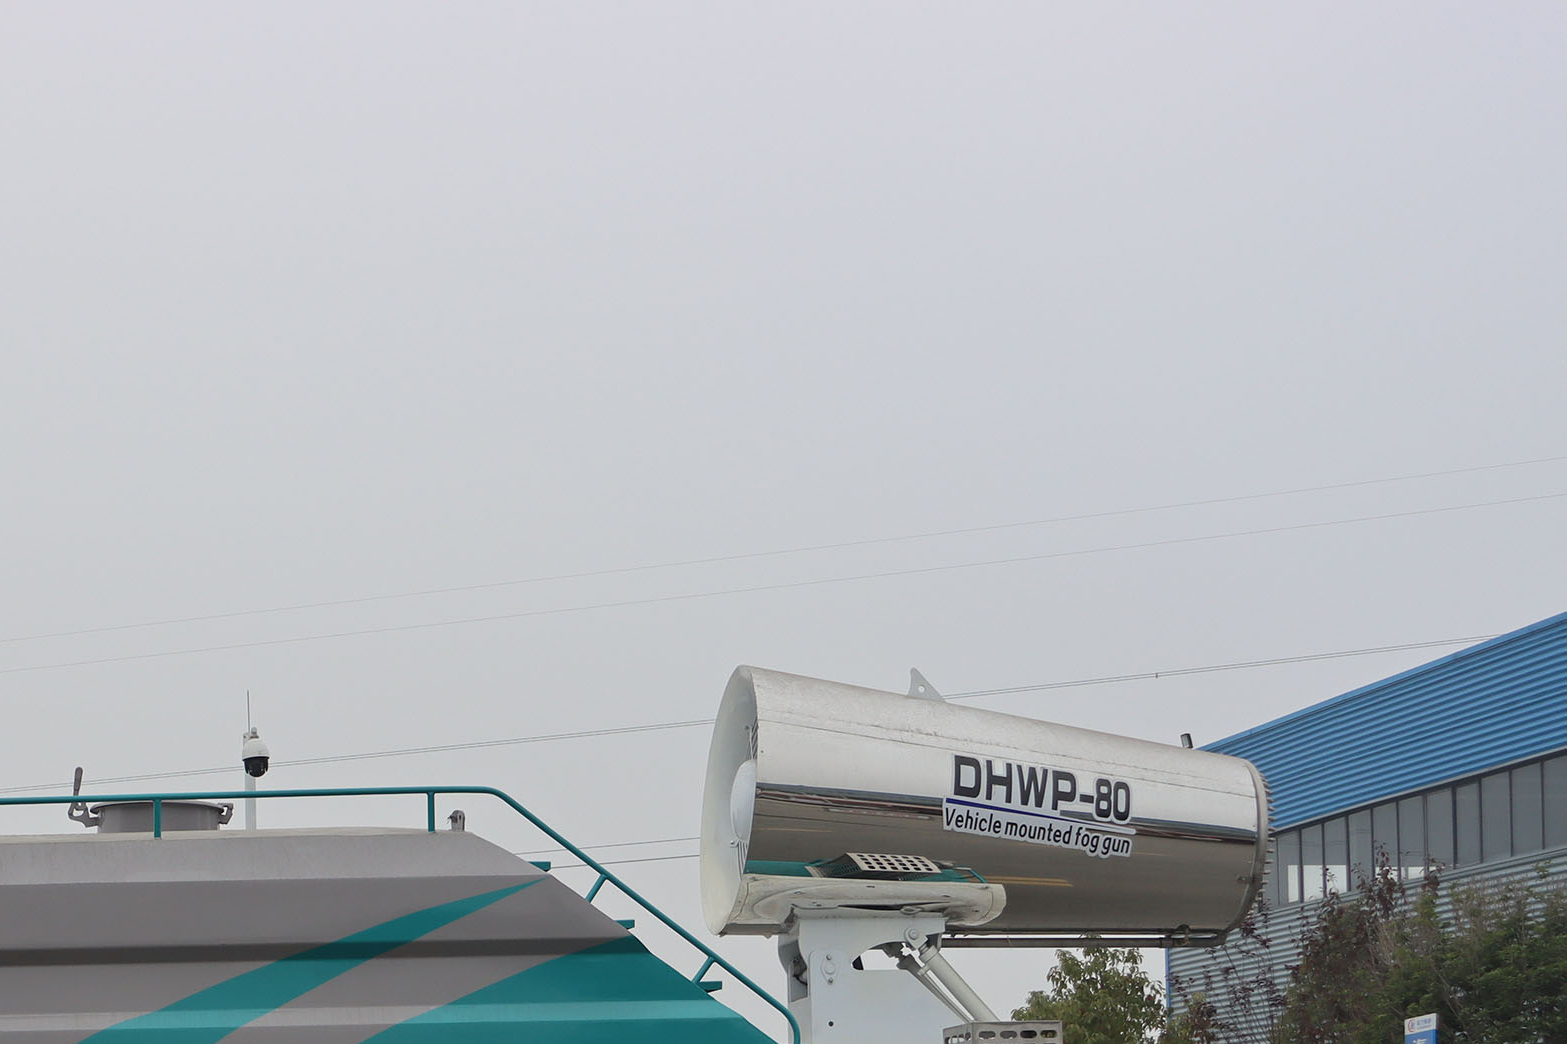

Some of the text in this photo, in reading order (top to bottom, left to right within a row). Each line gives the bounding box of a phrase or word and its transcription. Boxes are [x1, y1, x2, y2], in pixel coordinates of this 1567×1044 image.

[953, 755, 1130, 821] DHWP-80
[945, 807, 1130, 855] Vehicle mounted fog gun
